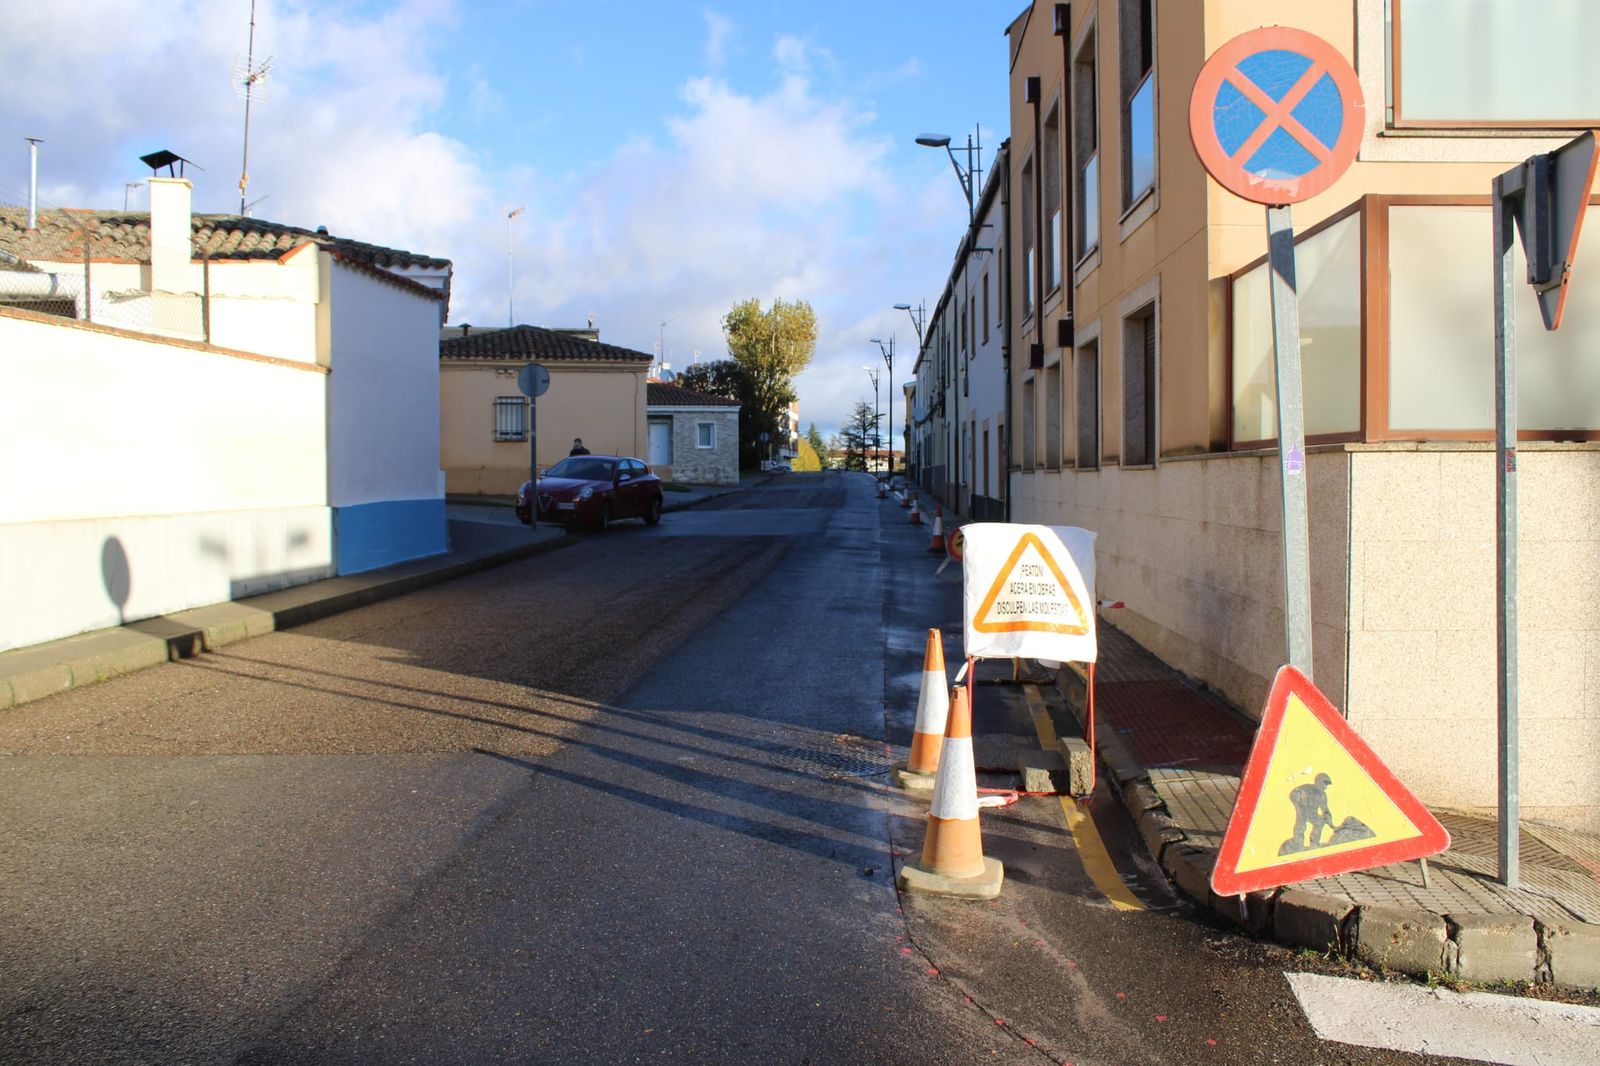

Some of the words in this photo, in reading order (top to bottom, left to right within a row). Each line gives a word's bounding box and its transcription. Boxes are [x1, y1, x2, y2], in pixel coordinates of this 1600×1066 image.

[1010, 582, 1028, 595] ACERA
[1029, 582, 1037, 596] EN
[1038, 583, 1056, 596] OBRAS
[997, 601, 1027, 615] DISCULPEN
[1028, 601, 1039, 615] LAS
